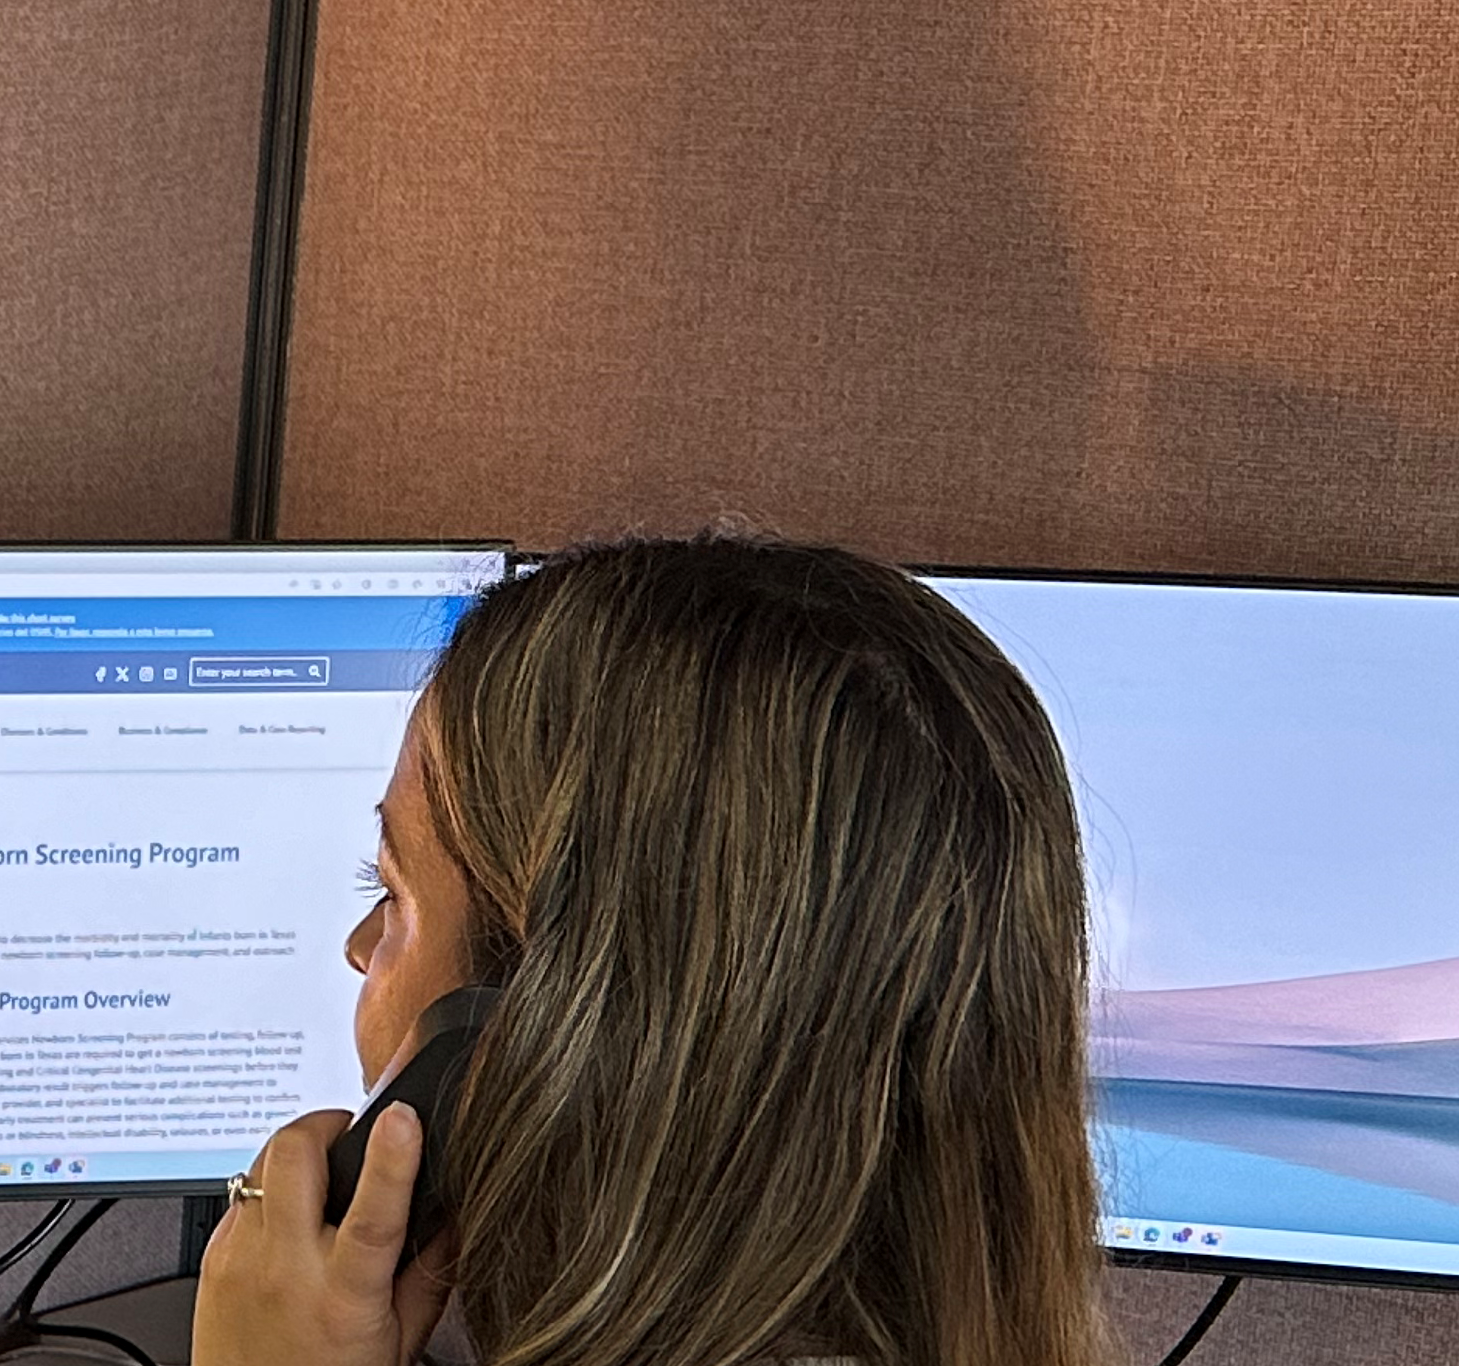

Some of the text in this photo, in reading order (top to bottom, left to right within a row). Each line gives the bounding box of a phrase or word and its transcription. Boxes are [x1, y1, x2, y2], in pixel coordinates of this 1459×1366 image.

[196, 667, 220, 677] Enter
[221, 669, 240, 679] your
[242, 667, 271, 677] search
[35, 844, 141, 870] Screening
[150, 842, 240, 868] Program
[0, 991, 78, 1015] Program
[84, 990, 171, 1010] Overview
